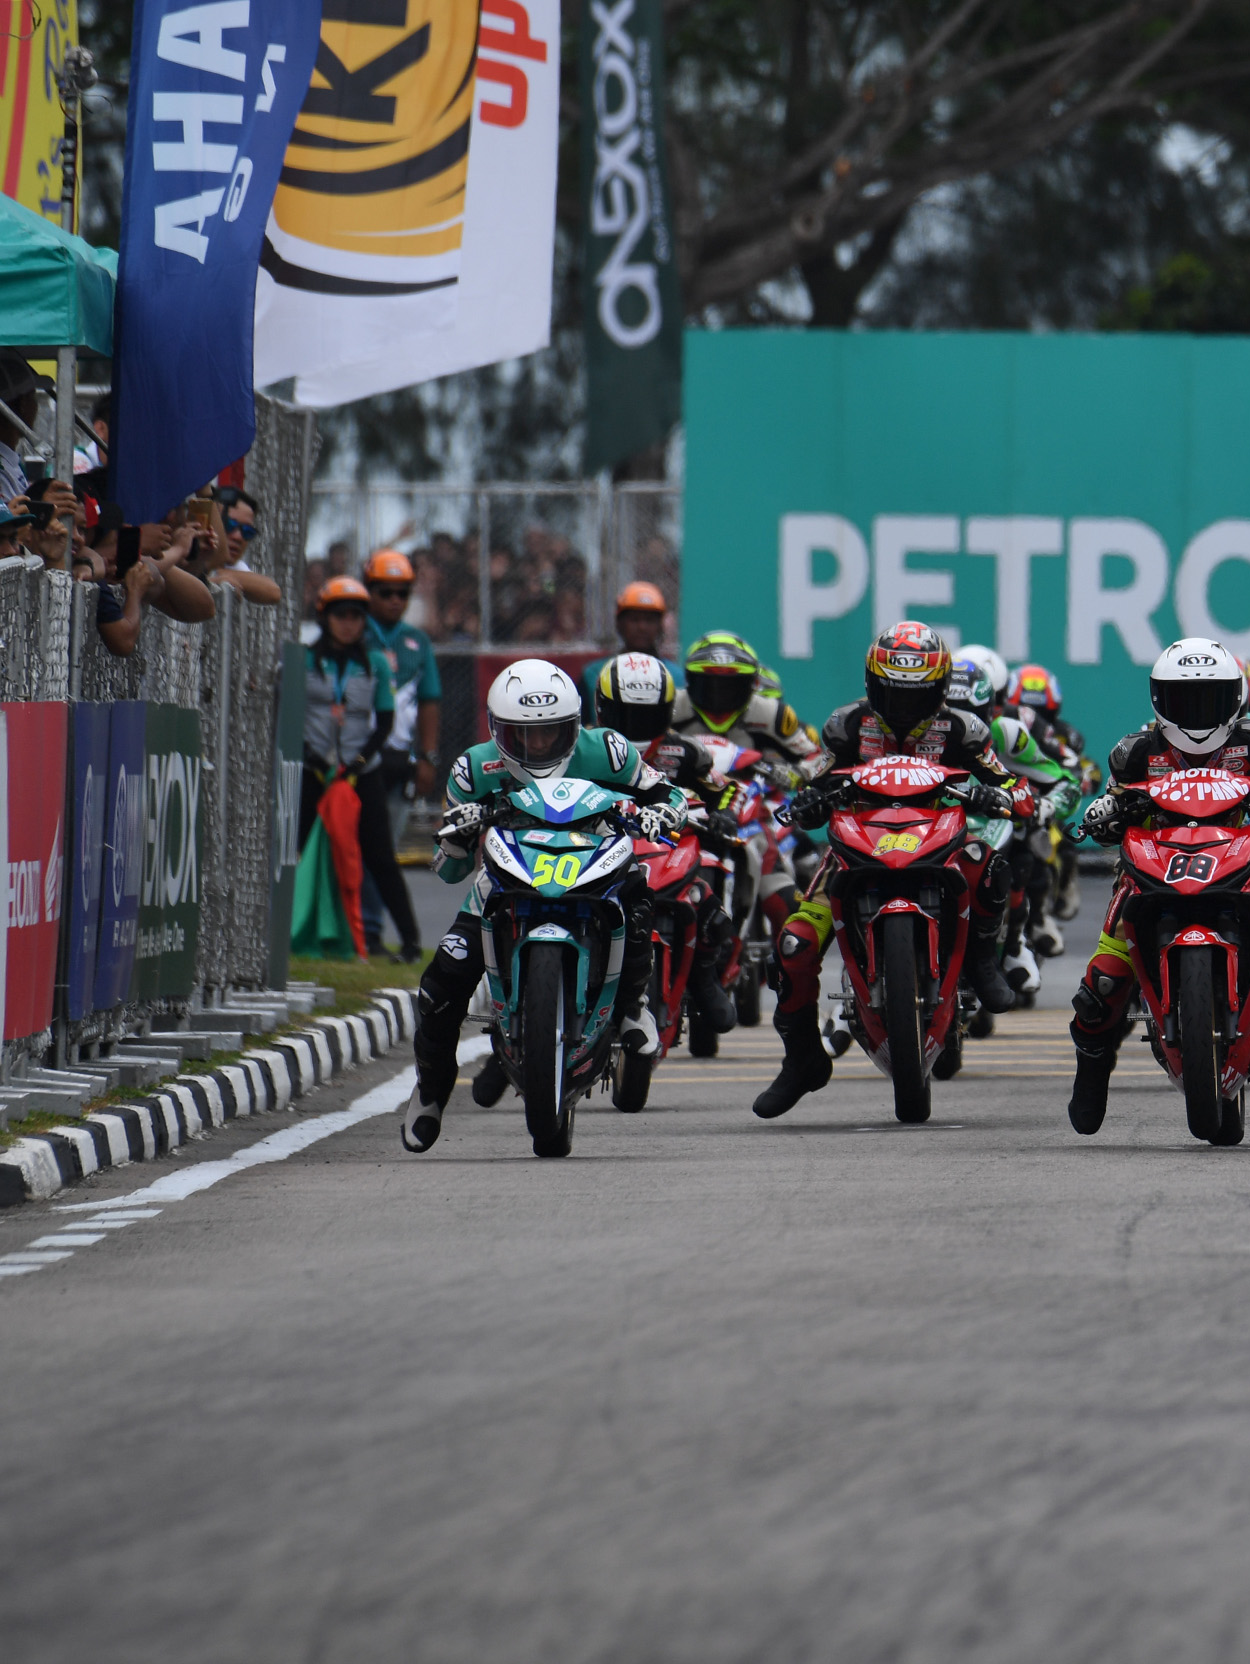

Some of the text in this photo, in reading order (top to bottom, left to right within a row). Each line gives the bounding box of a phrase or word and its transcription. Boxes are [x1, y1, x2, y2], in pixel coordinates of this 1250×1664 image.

[891, 656, 923, 667] KYT
[1181, 655, 1214, 666] KYT
[521, 693, 556, 705] KYT
[873, 755, 929, 768] MOTUL
[1170, 768, 1229, 782] MOTUL
[874, 832, 922, 855] 98
[531, 854, 581, 888] 50
[1165, 852, 1218, 883] 88
